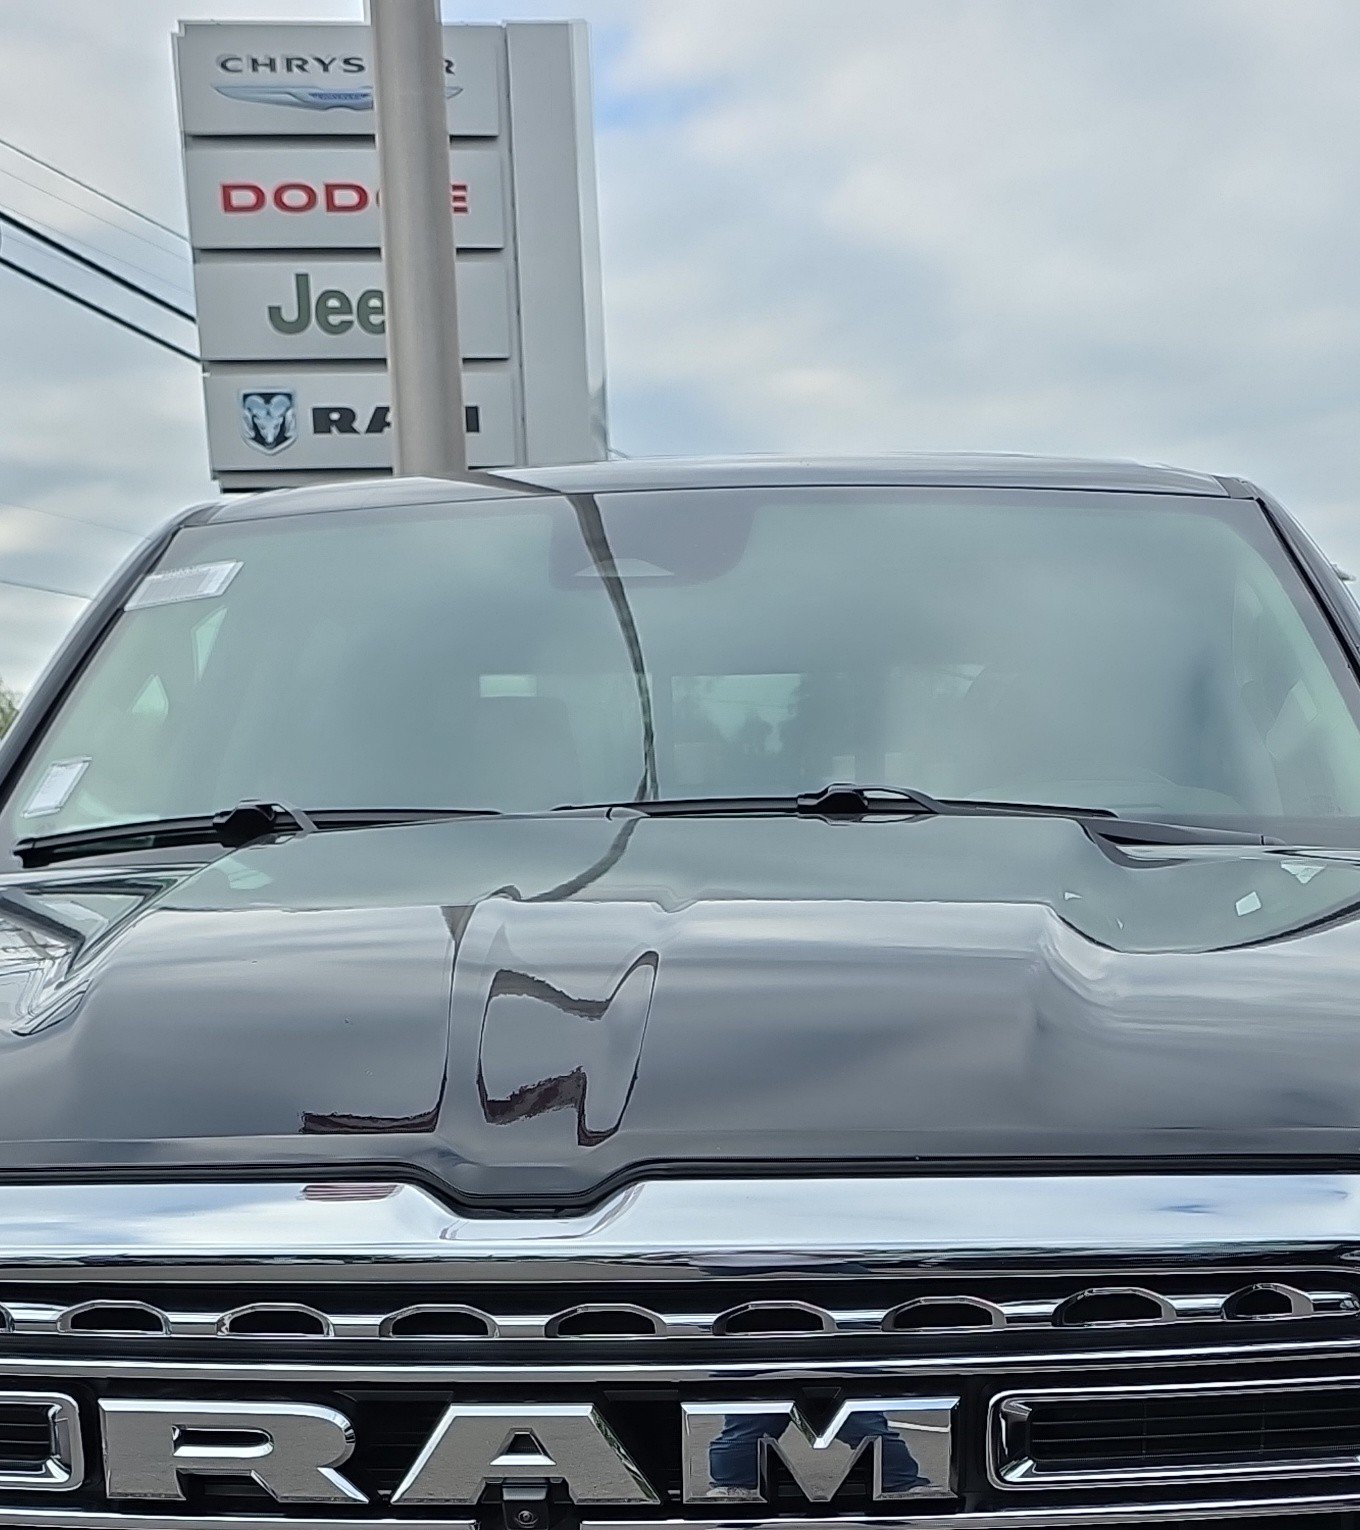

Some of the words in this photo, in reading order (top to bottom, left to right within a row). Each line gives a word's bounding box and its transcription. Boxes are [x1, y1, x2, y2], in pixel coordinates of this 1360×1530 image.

[220, 57, 455, 75] CHRYS
[221, 183, 468, 213] DOD
[268, 273, 385, 335] Jee
[312, 406, 480, 434] RA
[97, 1396, 962, 1505] RAM
